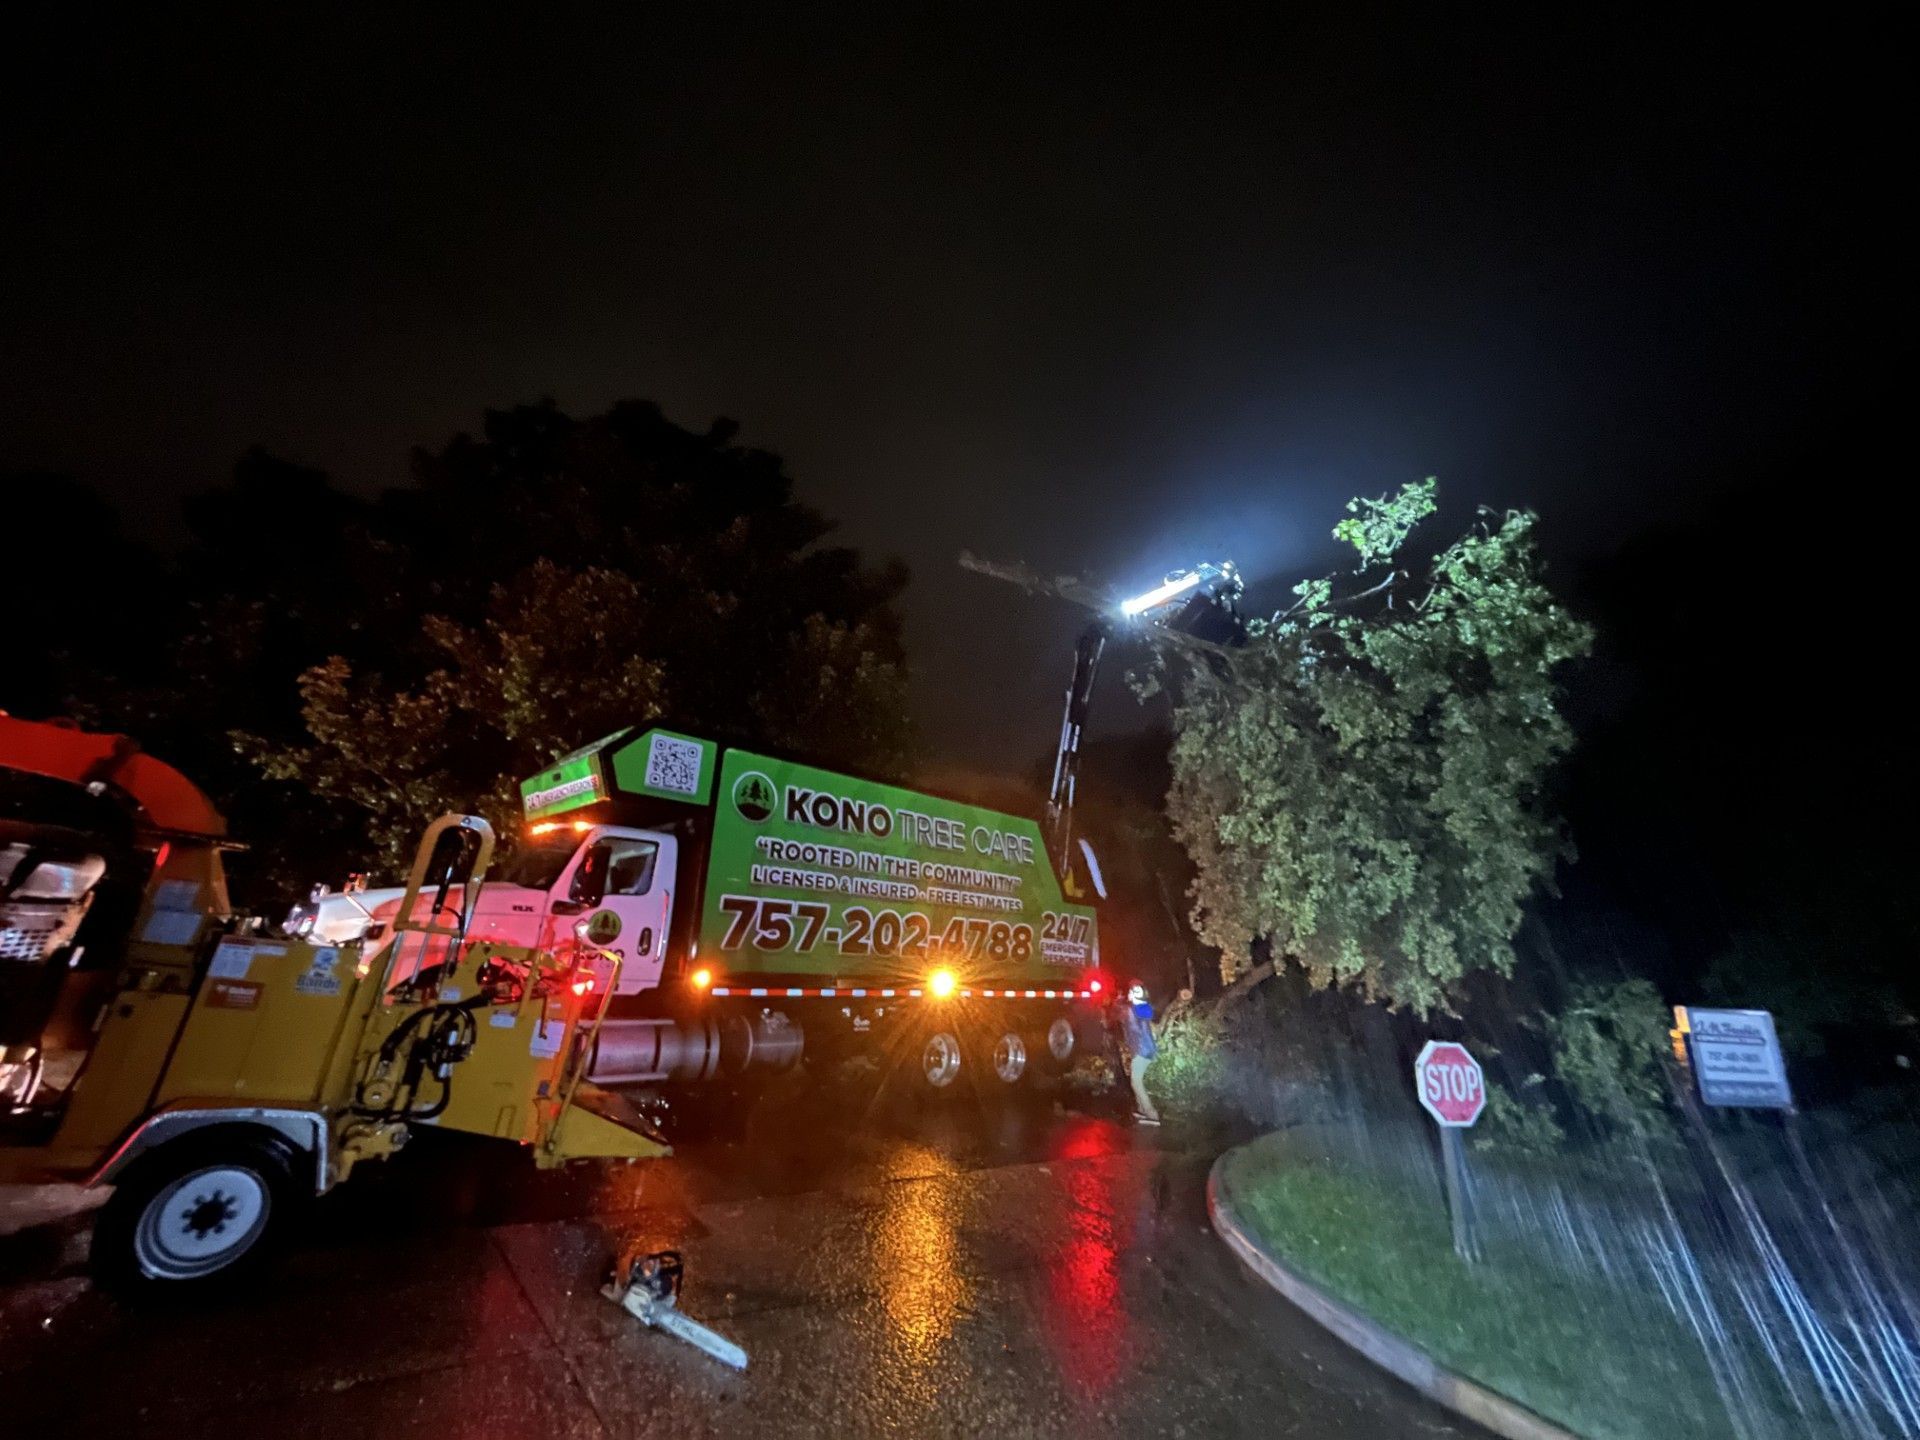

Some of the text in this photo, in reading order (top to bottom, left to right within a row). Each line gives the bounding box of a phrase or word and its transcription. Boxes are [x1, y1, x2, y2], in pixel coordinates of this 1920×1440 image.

[785, 785, 1035, 865] KONO TREE CARE
[860, 850, 881, 873] IN
[884, 855, 919, 879] THE
[751, 864, 1023, 911] LICENSED & INSURED FREE ESTIMATES
[719, 893, 1034, 963] 757-202-4788
[1040, 910, 1091, 947] 24/7
[1425, 1063, 1479, 1103] STOP
